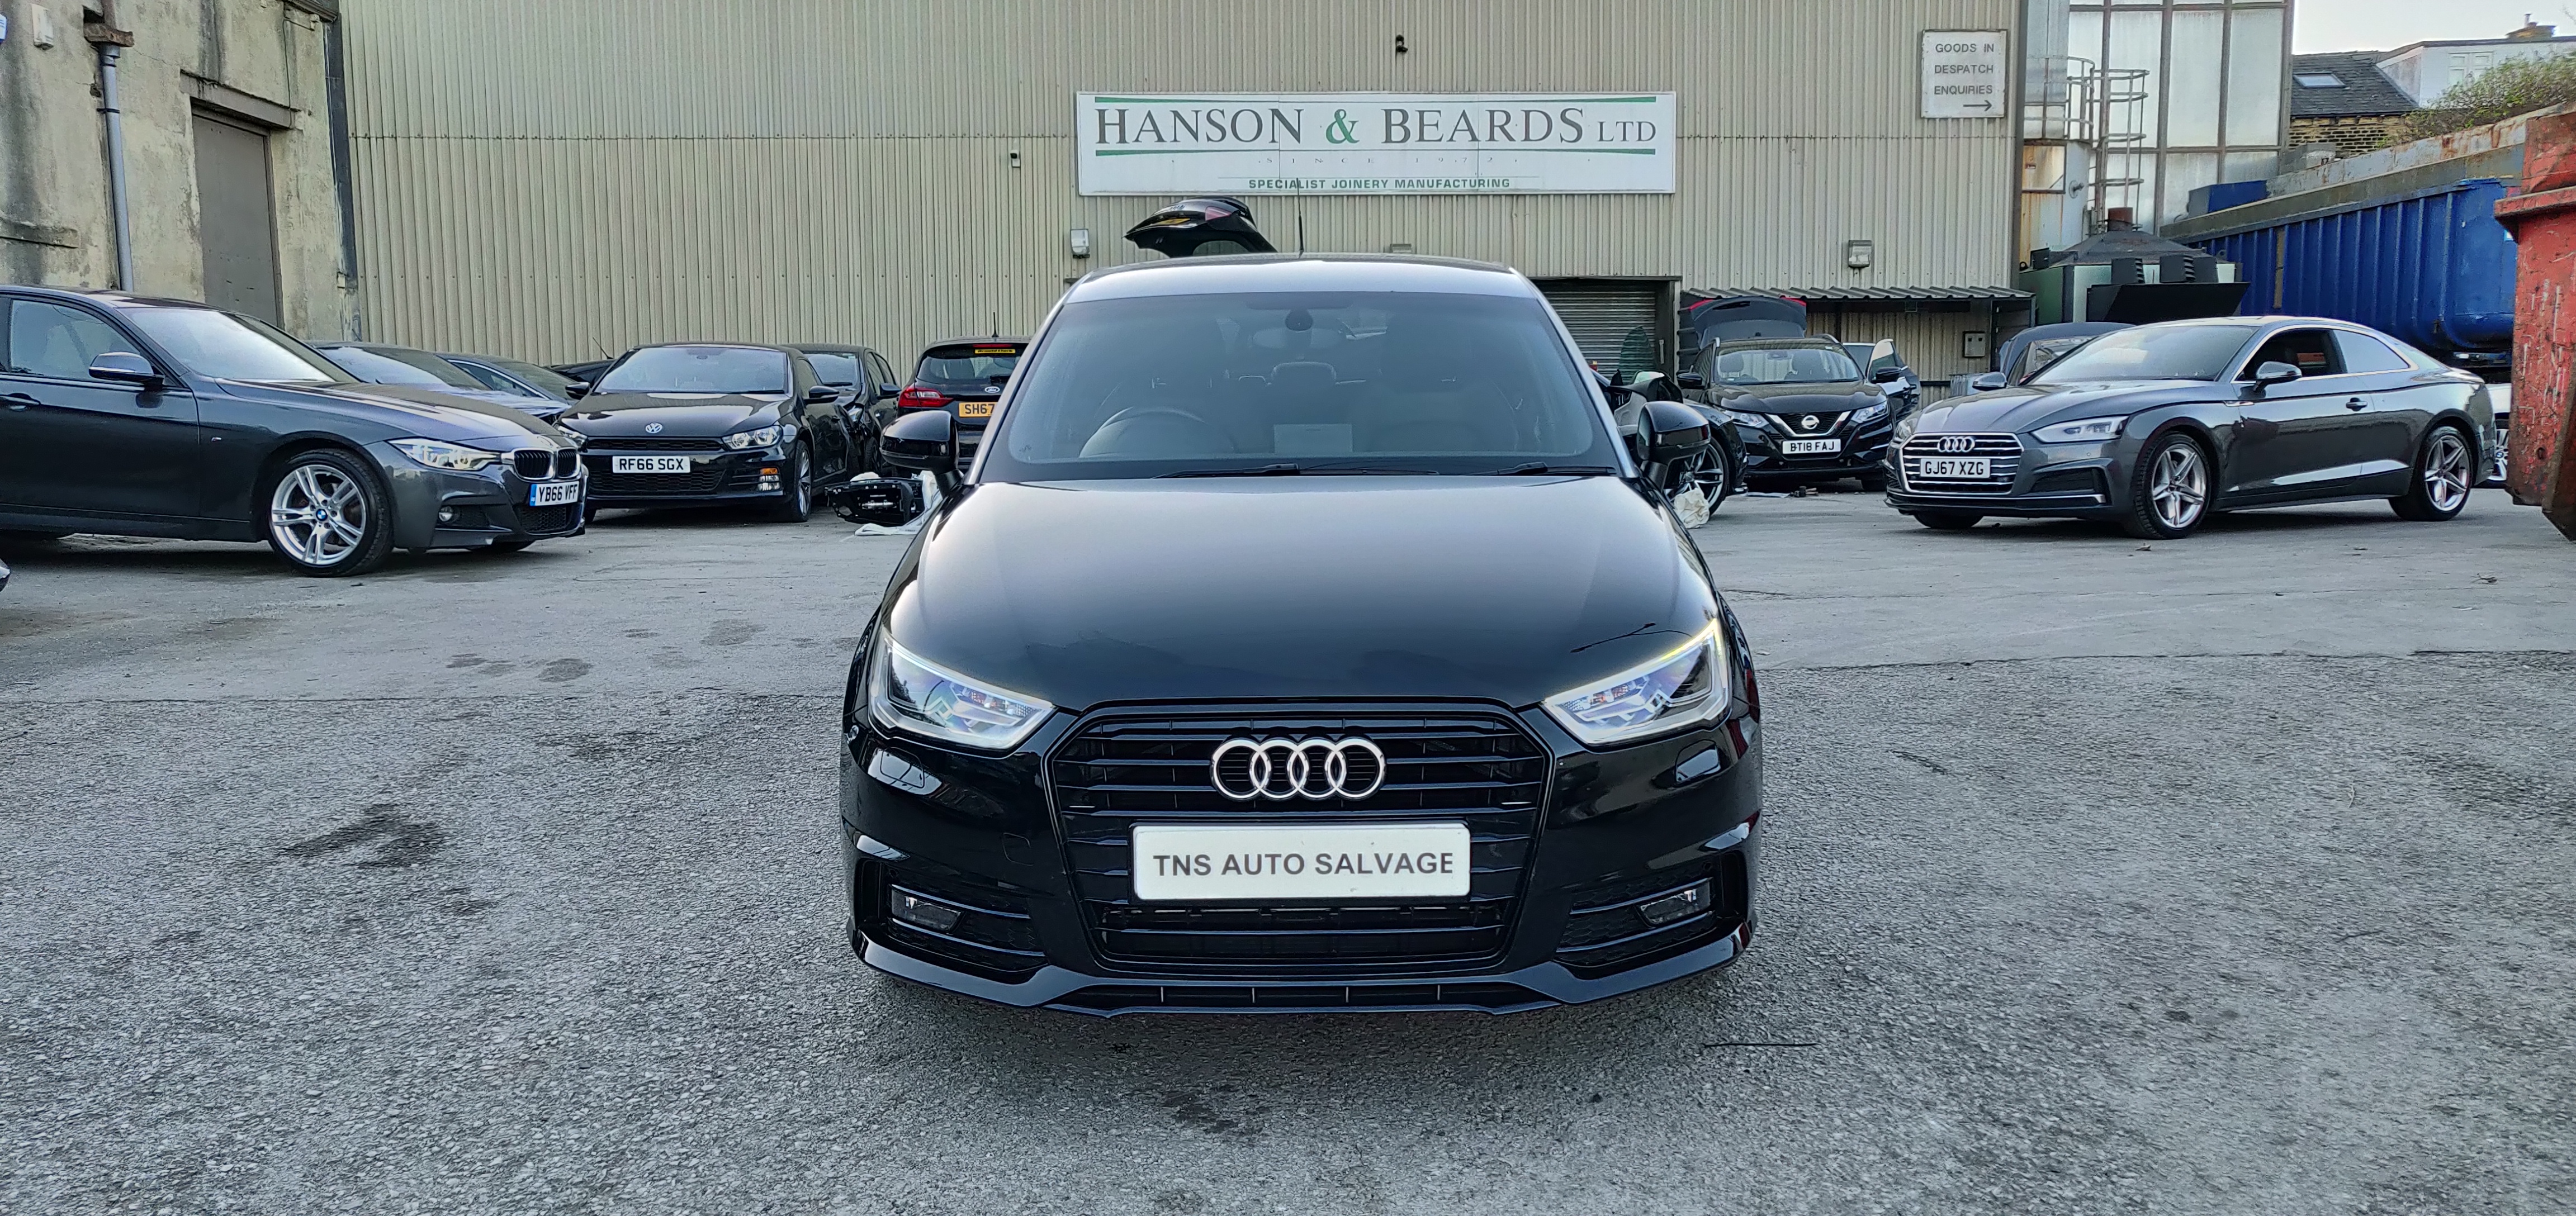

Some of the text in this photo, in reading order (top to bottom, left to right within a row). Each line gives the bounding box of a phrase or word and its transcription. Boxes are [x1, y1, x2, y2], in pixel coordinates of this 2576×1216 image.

[1935, 43, 1994, 53] GOODS IN
[1934, 64, 1993, 74] DESPATCH
[1934, 84, 1993, 95] ENQUIRIES
[1095, 107, 1656, 144] HANSON & BEARDS LTD
[1249, 178, 1510, 189] SPECIALIST JOINERY MANUFACTURING
[964, 403, 995, 414] SH67
[1790, 441, 1834, 452] BT18 FAJ
[619, 458, 684, 471] RF66 SGX
[1925, 461, 1984, 475] GJ67 XZG
[539, 484, 578, 502] YB66 VFF
[1153, 852, 1453, 876] TNS AUTO SALVAGE
